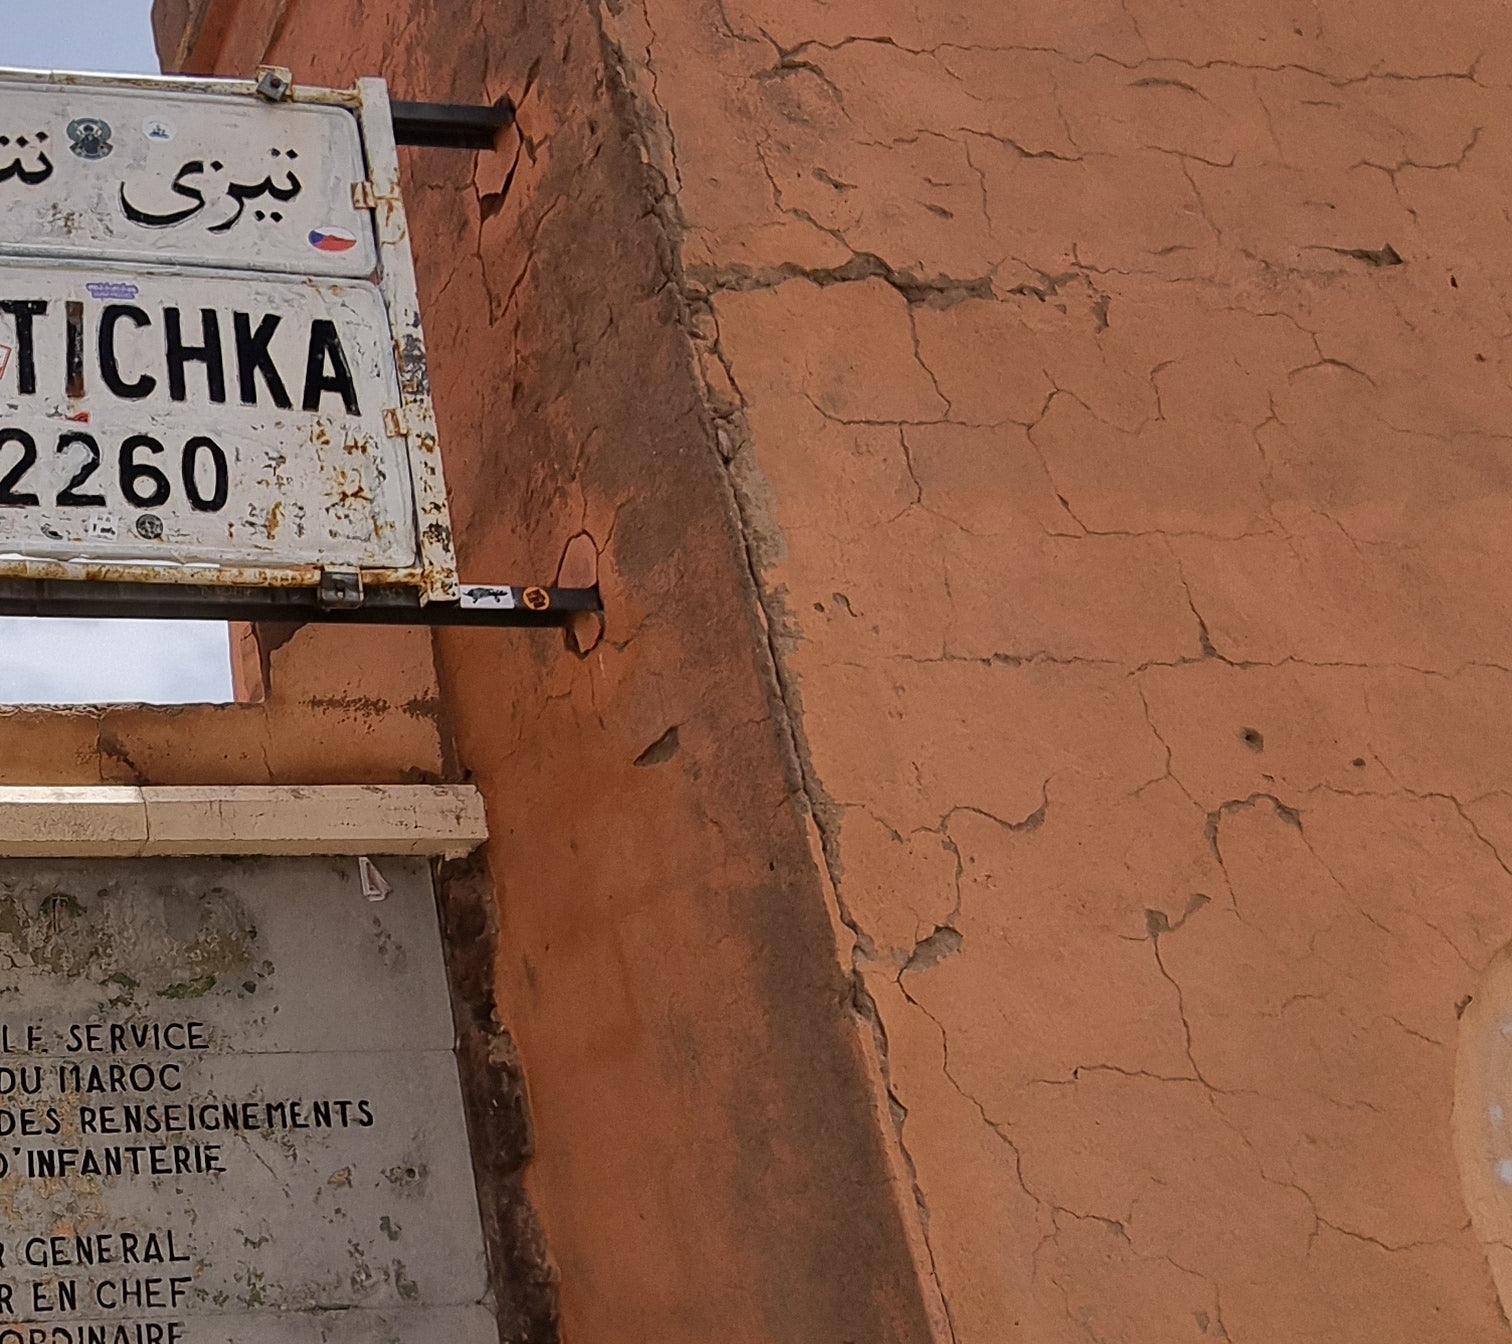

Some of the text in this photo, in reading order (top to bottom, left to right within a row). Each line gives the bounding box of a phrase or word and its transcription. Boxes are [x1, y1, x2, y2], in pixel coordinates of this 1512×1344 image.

[2, 1023, 48, 1054] LE
[65, 1022, 210, 1054] SERVICE
[60, 1061, 181, 1093] MAROC
[80, 1100, 373, 1134] RENSEIGNEMENTS
[26, 1230, 190, 1267] GENERAL
[32, 1280, 76, 1312] EN
[97, 1277, 192, 1309] CHEF
